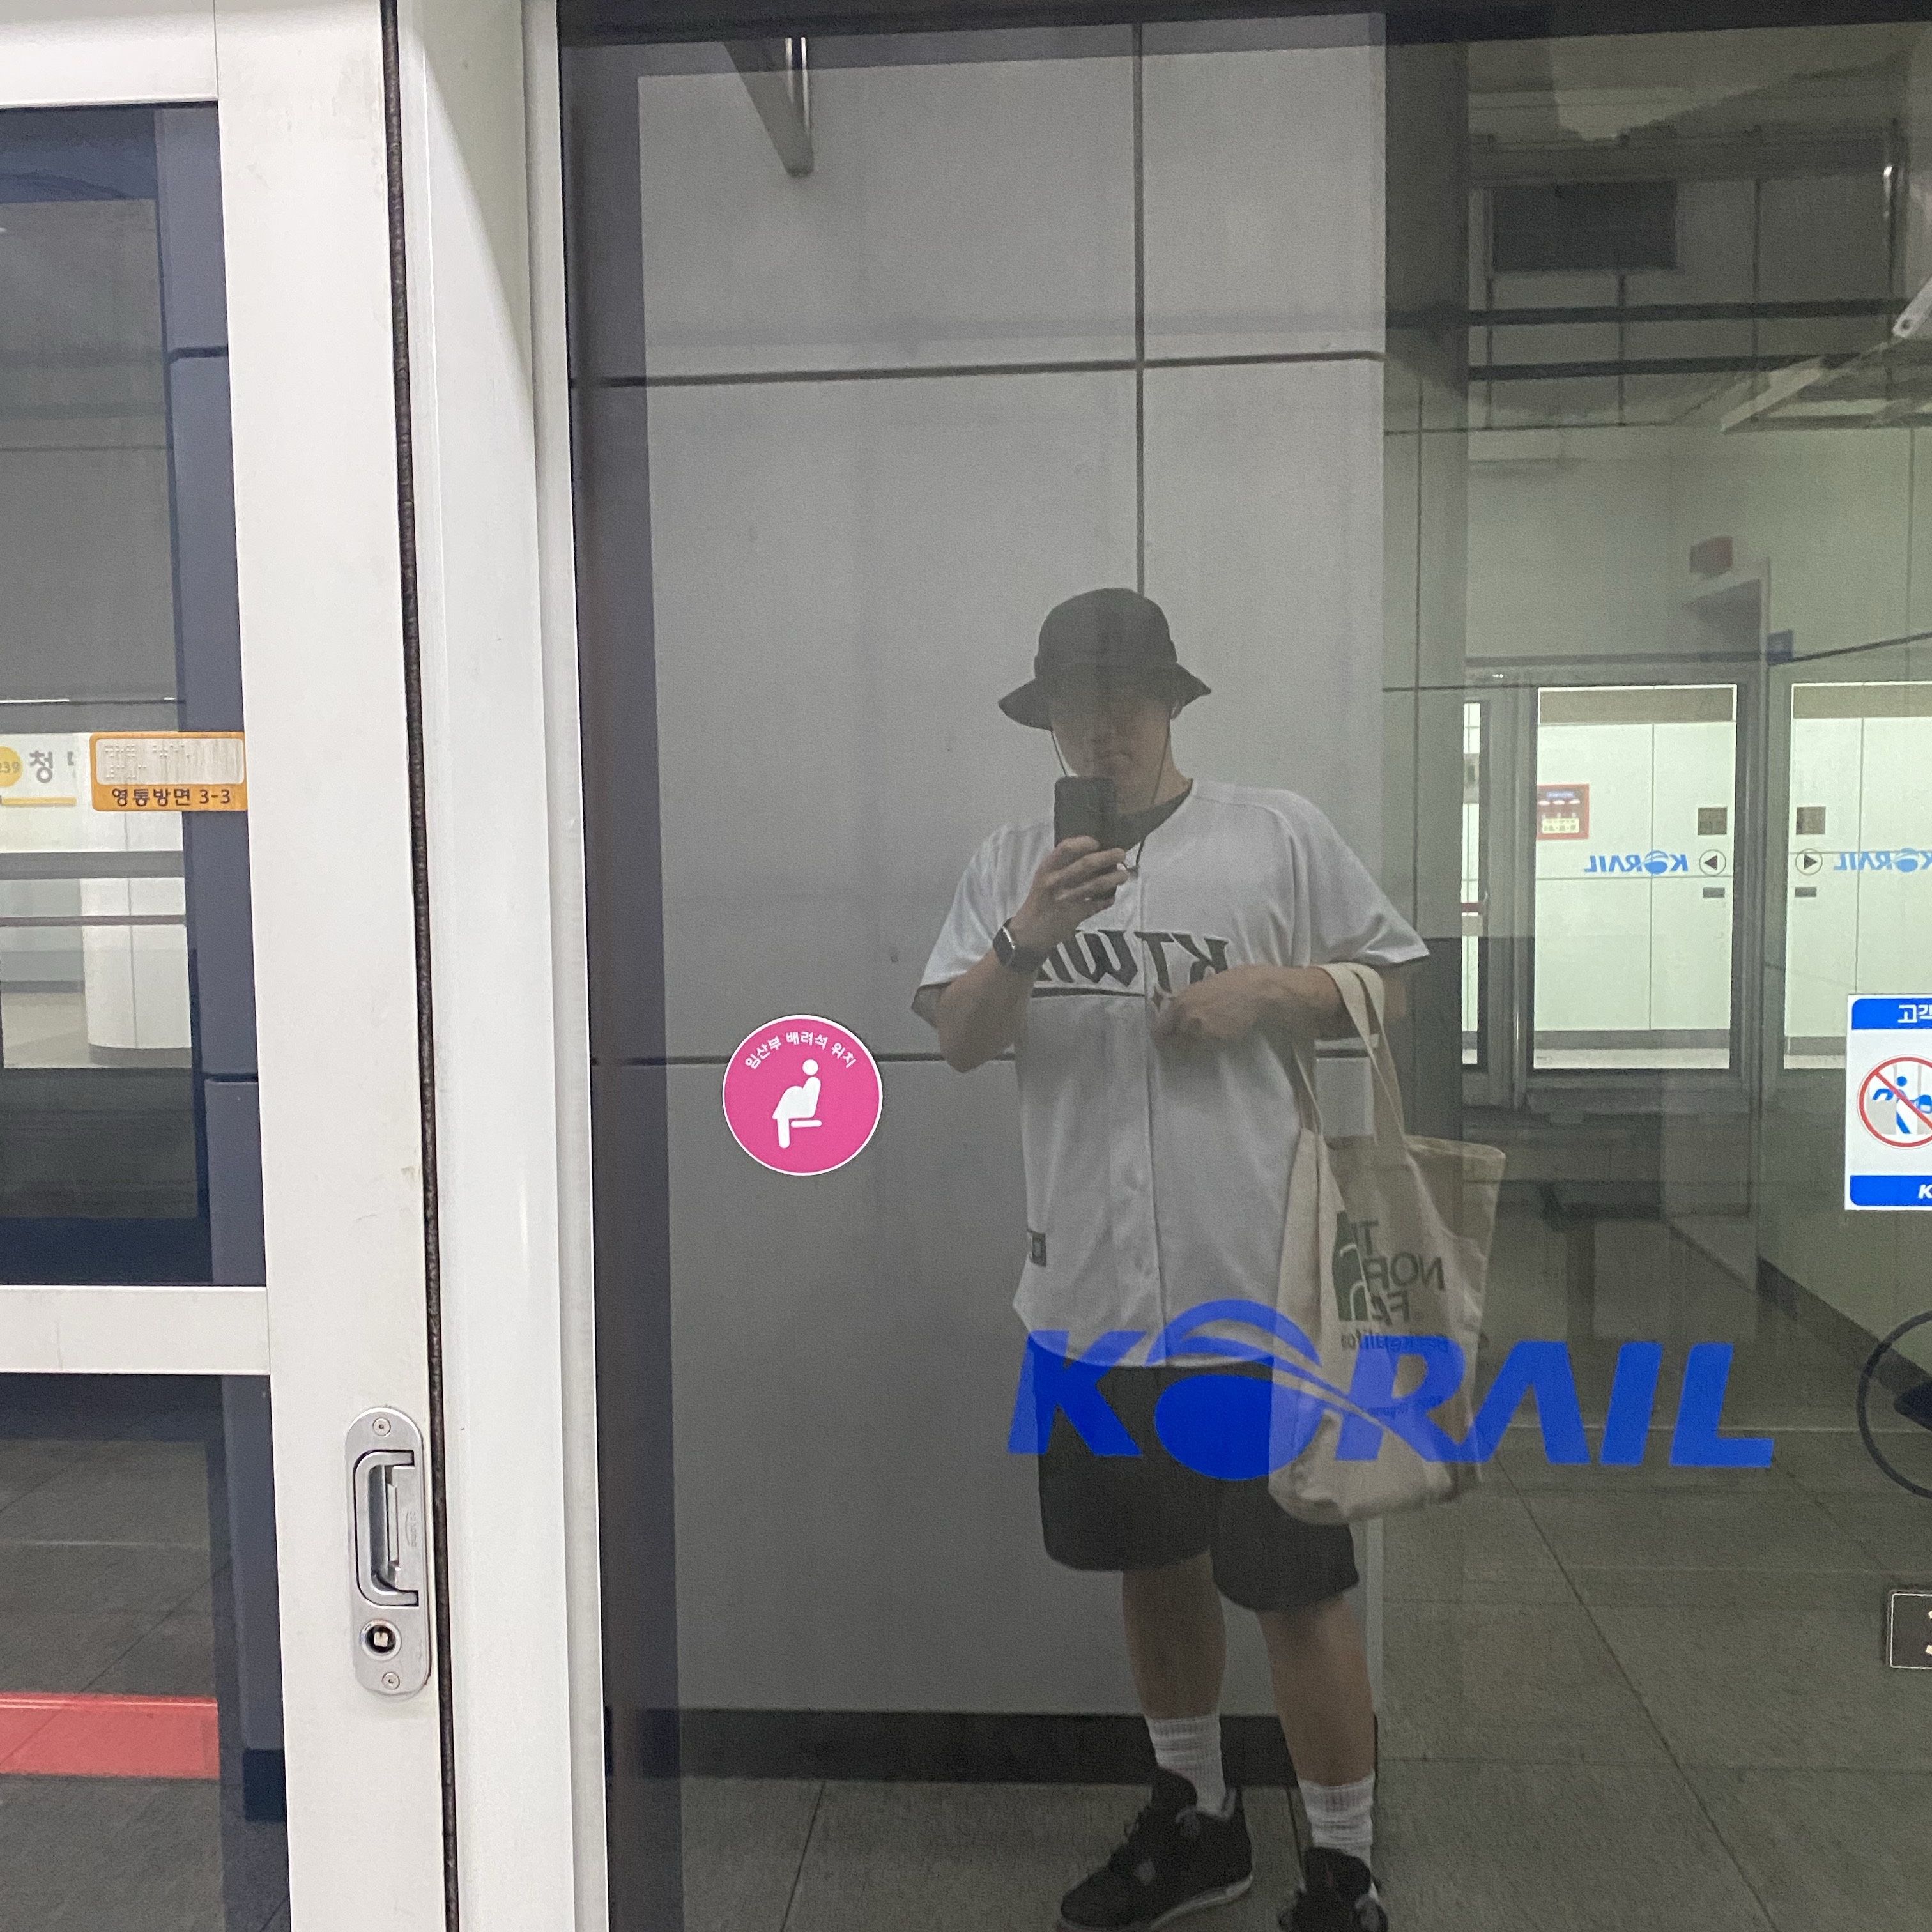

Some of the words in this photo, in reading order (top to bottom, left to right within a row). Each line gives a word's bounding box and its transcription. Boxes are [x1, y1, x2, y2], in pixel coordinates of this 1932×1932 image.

[112, 788, 191, 806] 영통방면
[199, 789, 231, 804] 3-3
[745, 1036, 782, 1070] 임산부
[785, 1031, 829, 1050] 배려석
[831, 1042, 857, 1068] 위치
[1007, 1298, 1775, 1481] KORAIL
